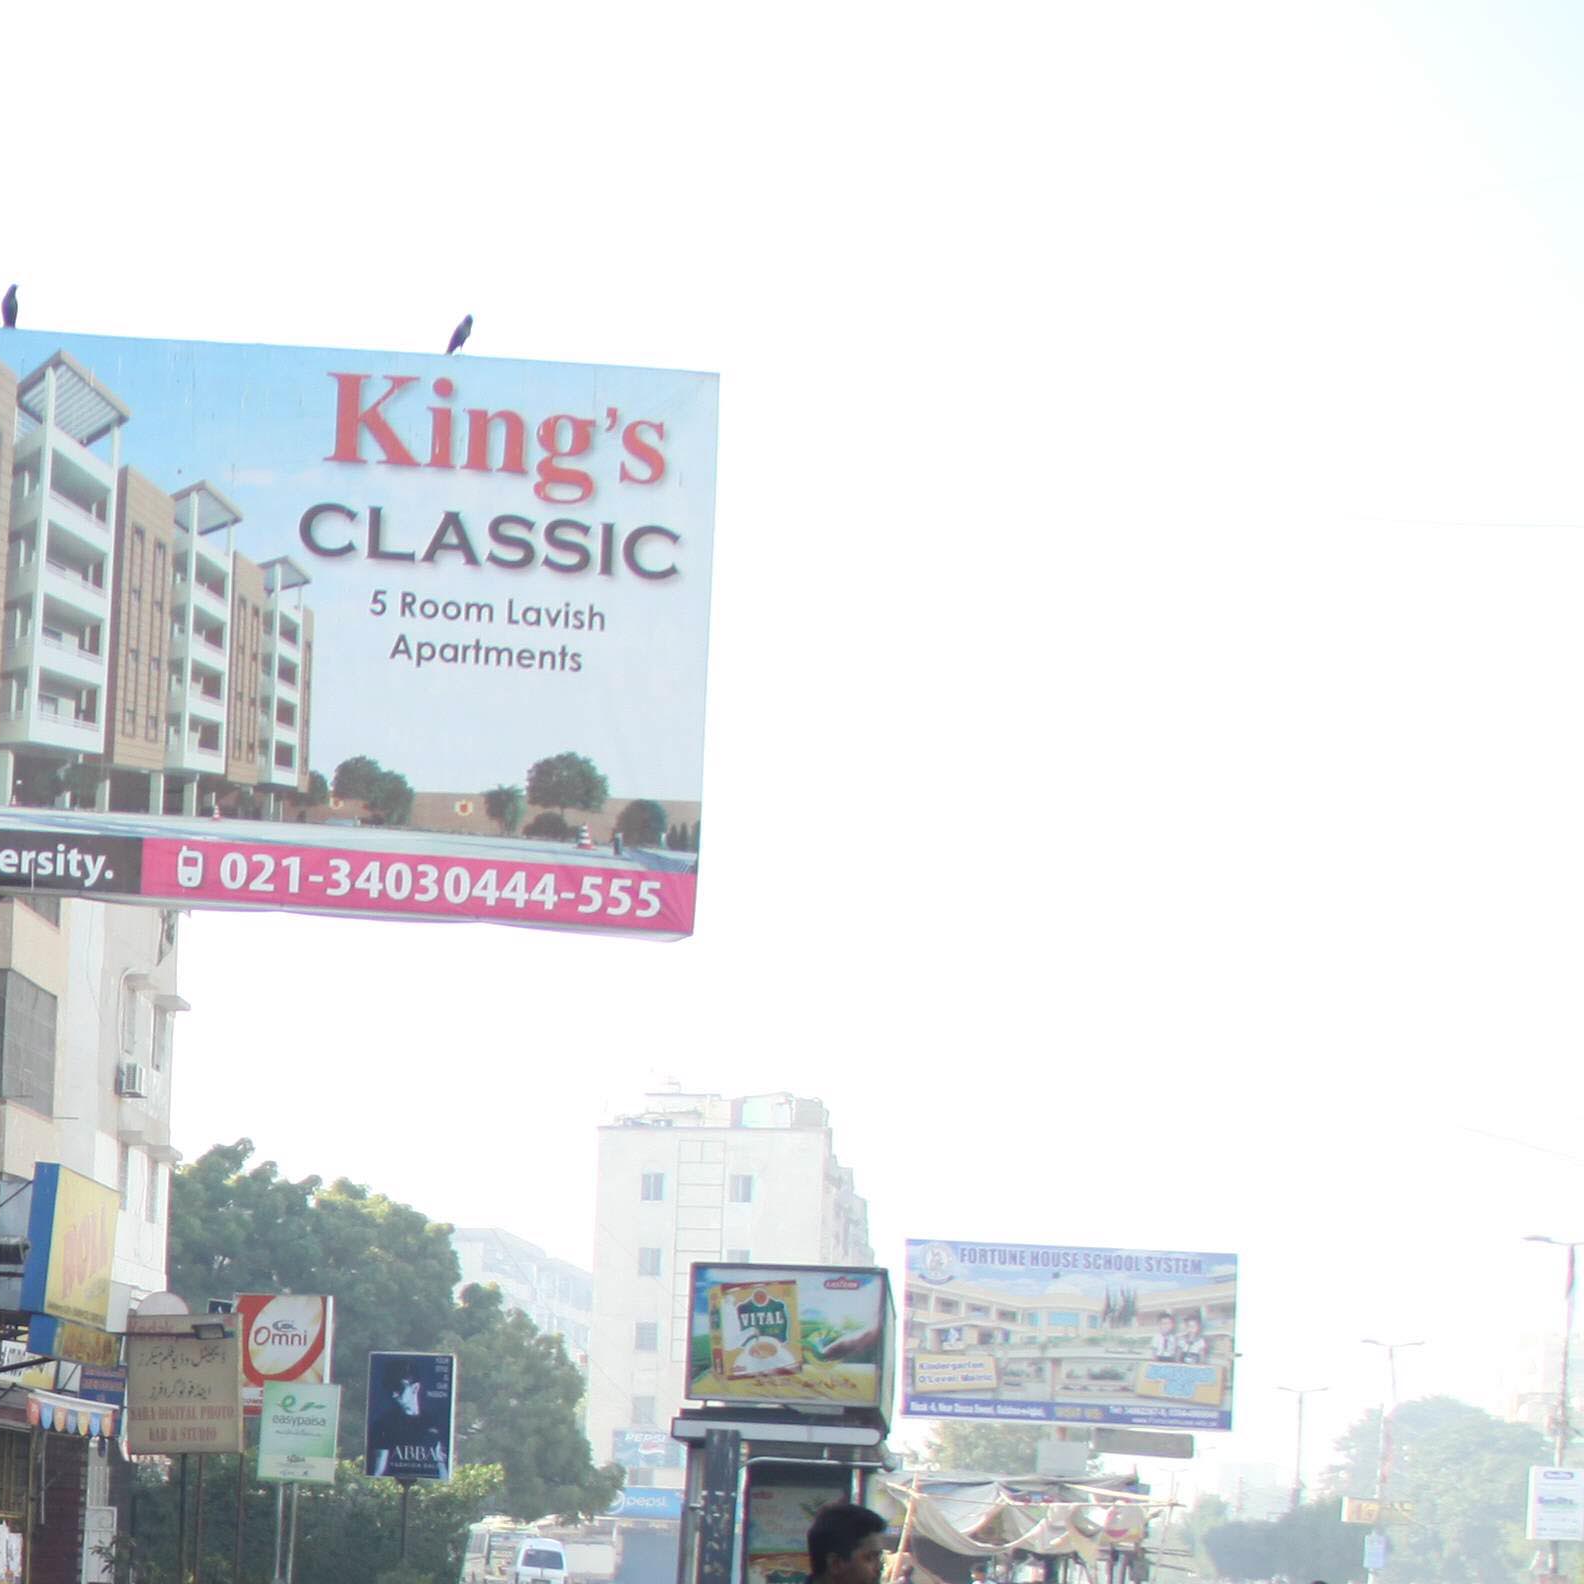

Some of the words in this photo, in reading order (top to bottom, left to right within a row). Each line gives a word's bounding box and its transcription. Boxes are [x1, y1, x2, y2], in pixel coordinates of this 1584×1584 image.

[322, 372, 666, 505] King's
[299, 502, 681, 581] CLASSIC
[369, 590, 387, 616] 5
[400, 591, 494, 622] Room
[507, 598, 606, 631] Lavish
[390, 633, 583, 672] Apartments
[219, 853, 662, 918] 021-34030444-555
[959, 1247, 1026, 1265] FORTUNE
[1031, 1250, 1079, 1269] HOUSE
[1082, 1252, 1141, 1272] SCHOOL
[1144, 1255, 1203, 1275] SYSTEM
[253, 1326, 308, 1347] Omni
[740, 1311, 784, 1327] VITAL
[272, 1414, 327, 1428] easypaisa
